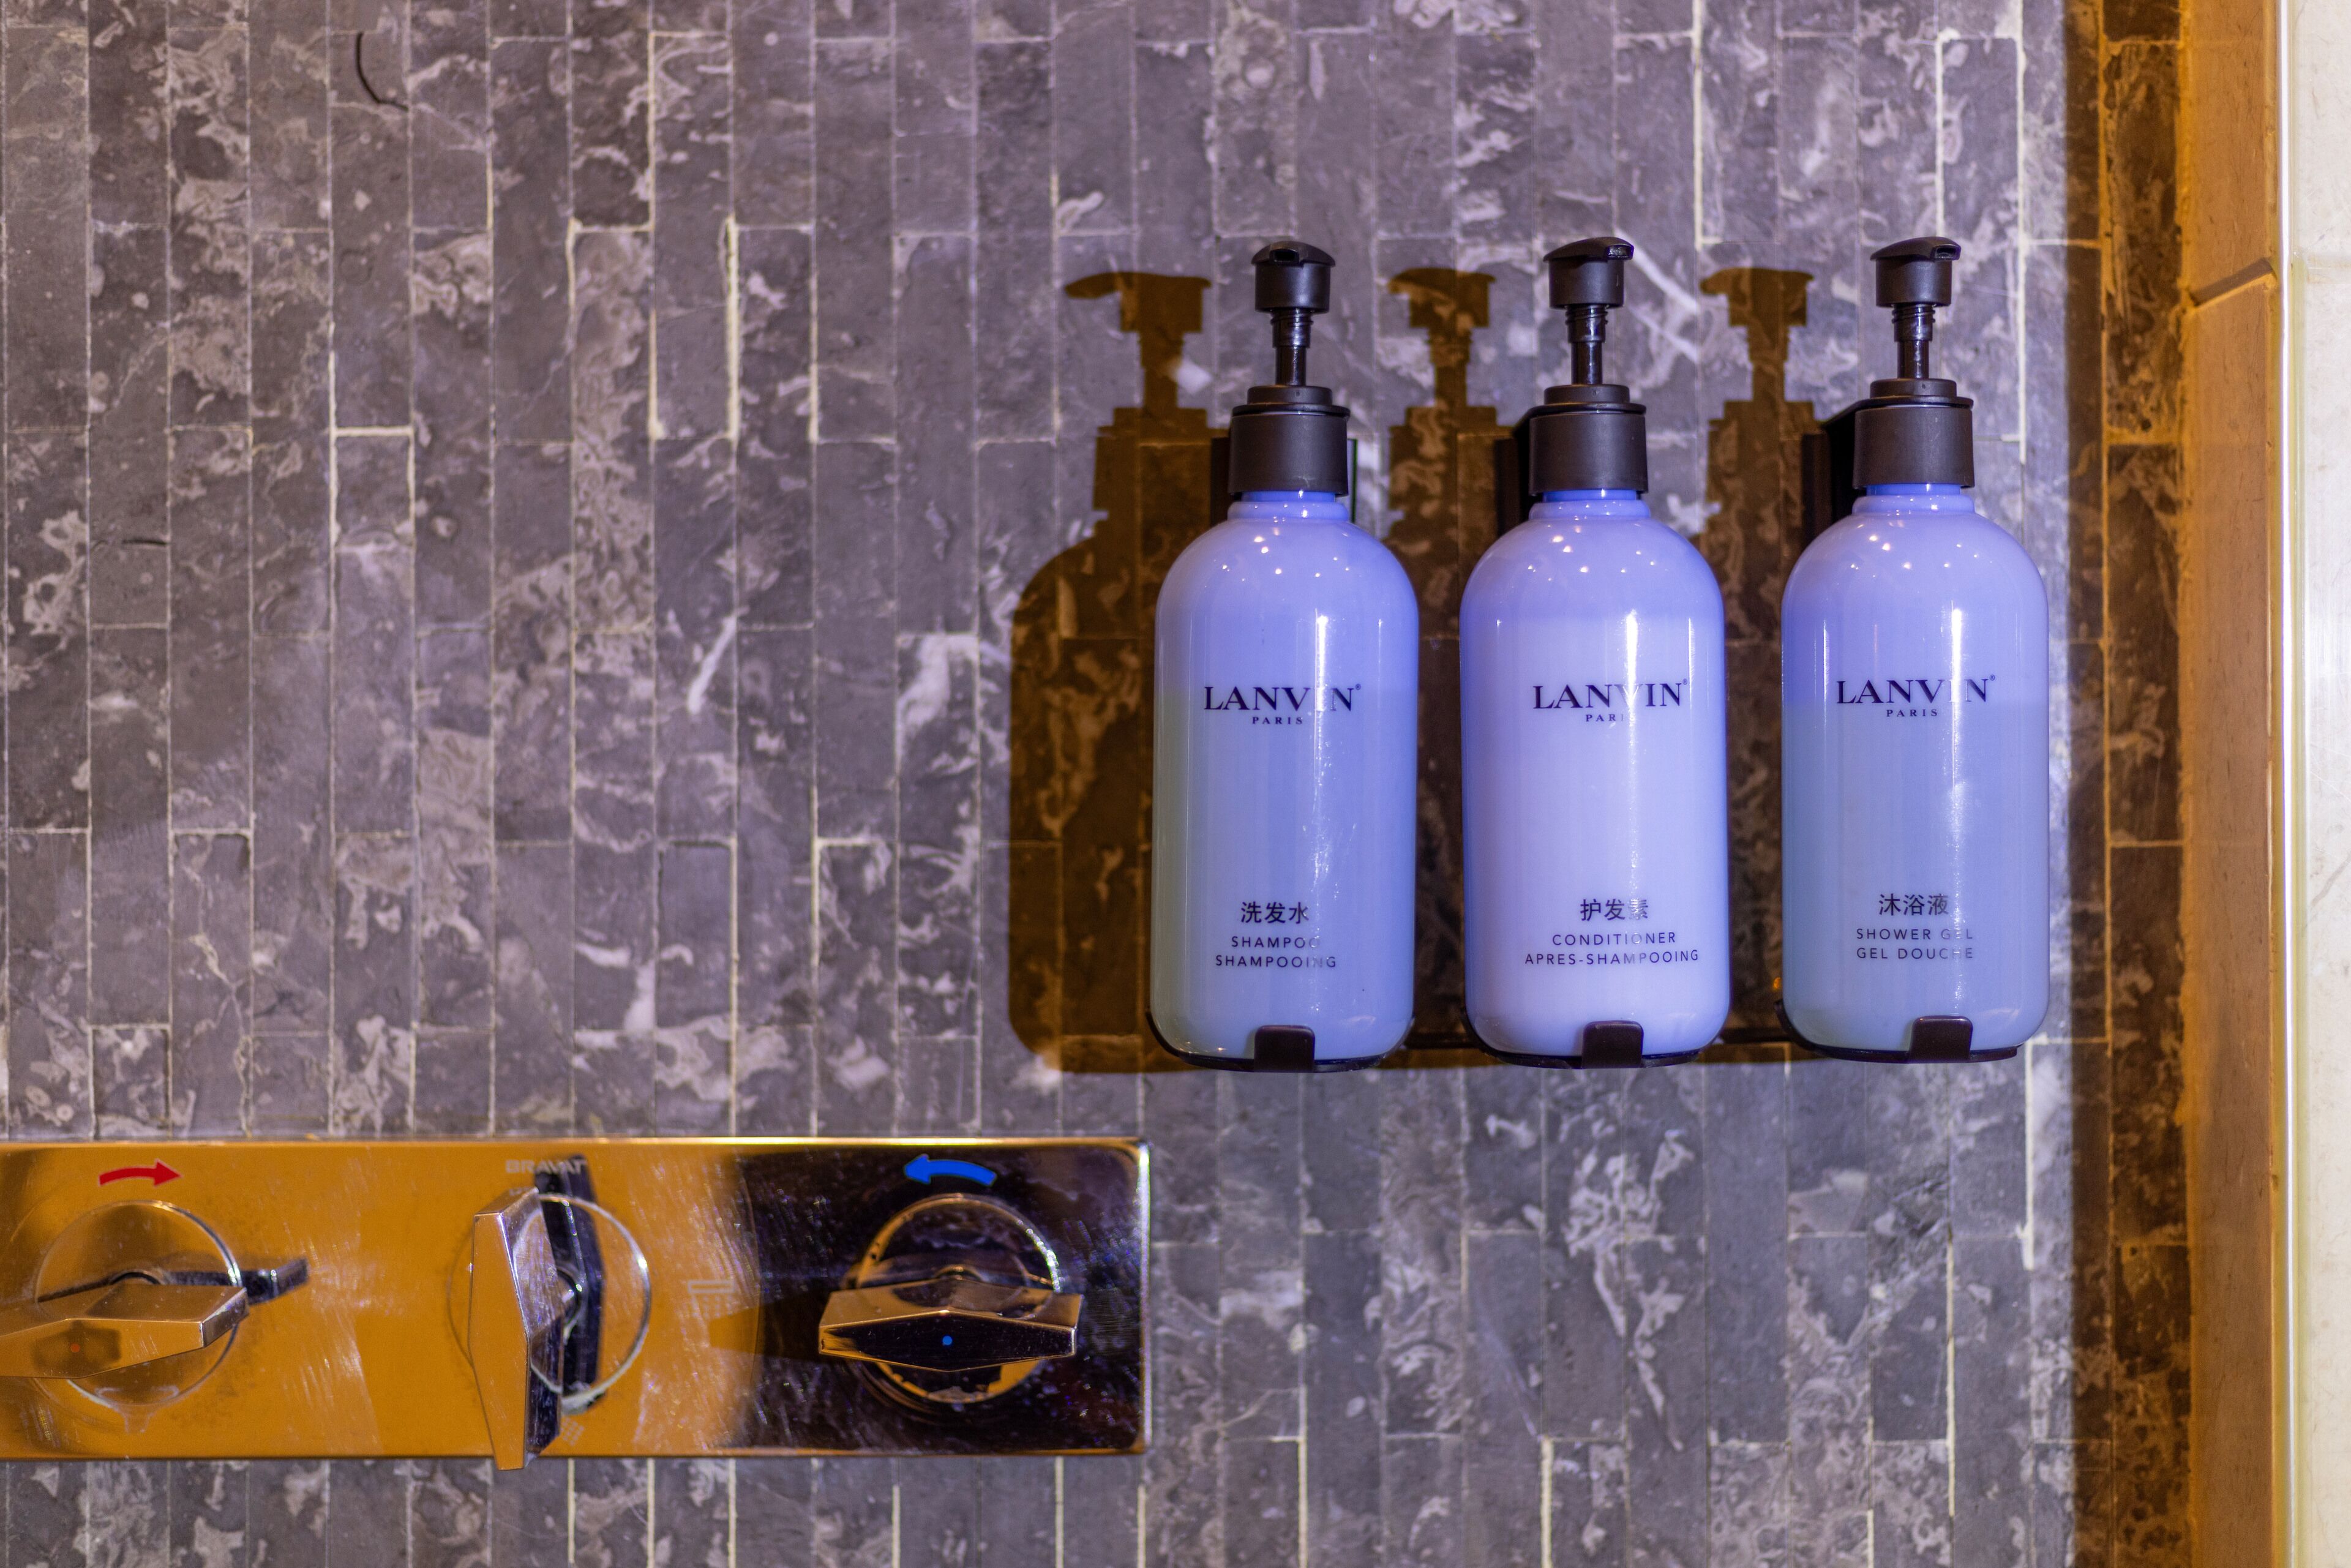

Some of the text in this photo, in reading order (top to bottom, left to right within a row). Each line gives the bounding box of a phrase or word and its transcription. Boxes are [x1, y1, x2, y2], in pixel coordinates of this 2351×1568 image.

[1886, 708, 1938, 717] PARIS
[1580, 898, 1649, 921] 护发素
[1878, 893, 1949, 916] 沐浴液
[1240, 901, 1310, 924] 洗发水
[1552, 932, 1676, 946] CONDITIONER
[1856, 928, 1932, 940] SHOWER
[1231, 936, 1320, 948] SHAMPOO
[1524, 950, 1699, 965] APRES-SHAMPOOING
[1856, 948, 1888, 959] GEL
[1215, 955, 1337, 967] SHAMPOOING
